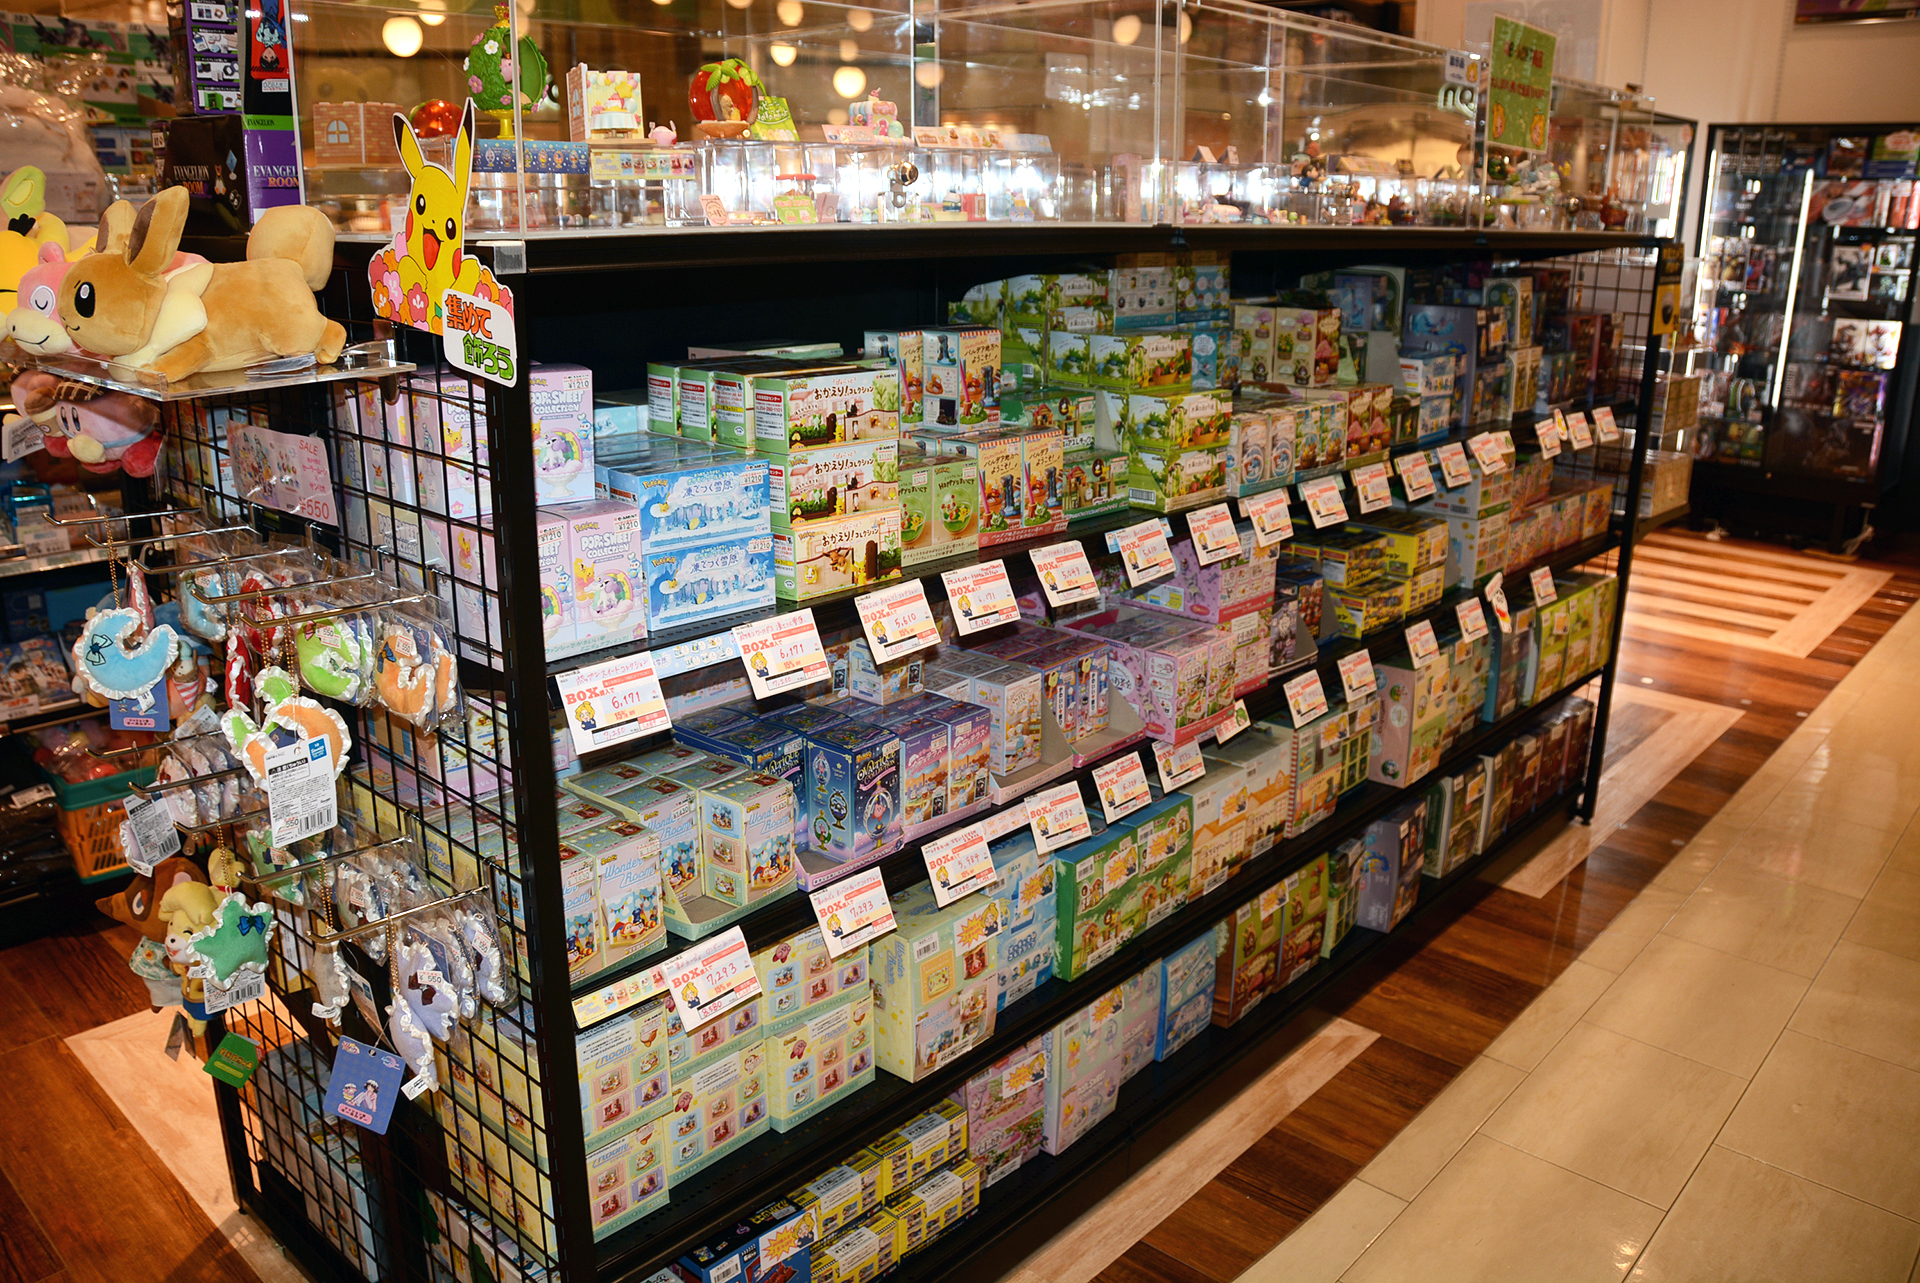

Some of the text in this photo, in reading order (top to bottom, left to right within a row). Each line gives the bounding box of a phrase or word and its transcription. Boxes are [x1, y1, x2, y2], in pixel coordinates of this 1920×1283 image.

[174, 165, 209, 181] EVANGELION
[445, 294, 492, 339] 集めて
[463, 333, 514, 380] 飾ろう
[533, 404, 580, 415] COLLECTION
[299, 439, 318, 456] SALE
[744, 475, 762, 483] ¥1210
[299, 497, 329, 519] ¥550
[619, 521, 638, 530] ¥1210
[541, 531, 561, 542] ¥1210
[587, 544, 629, 559] COLLECTION
[753, 542, 771, 550] ¥1210
[895, 613, 916, 628] 5,610
[780, 644, 804, 659] 6,171
[611, 691, 640, 709] 6,171
[604, 858, 643, 879] Wonder
[624, 866, 654, 886] Room
[850, 901, 874, 918] 7,293
[419, 973, 442, 984] ¥550
[706, 962, 737, 985] 7,293
